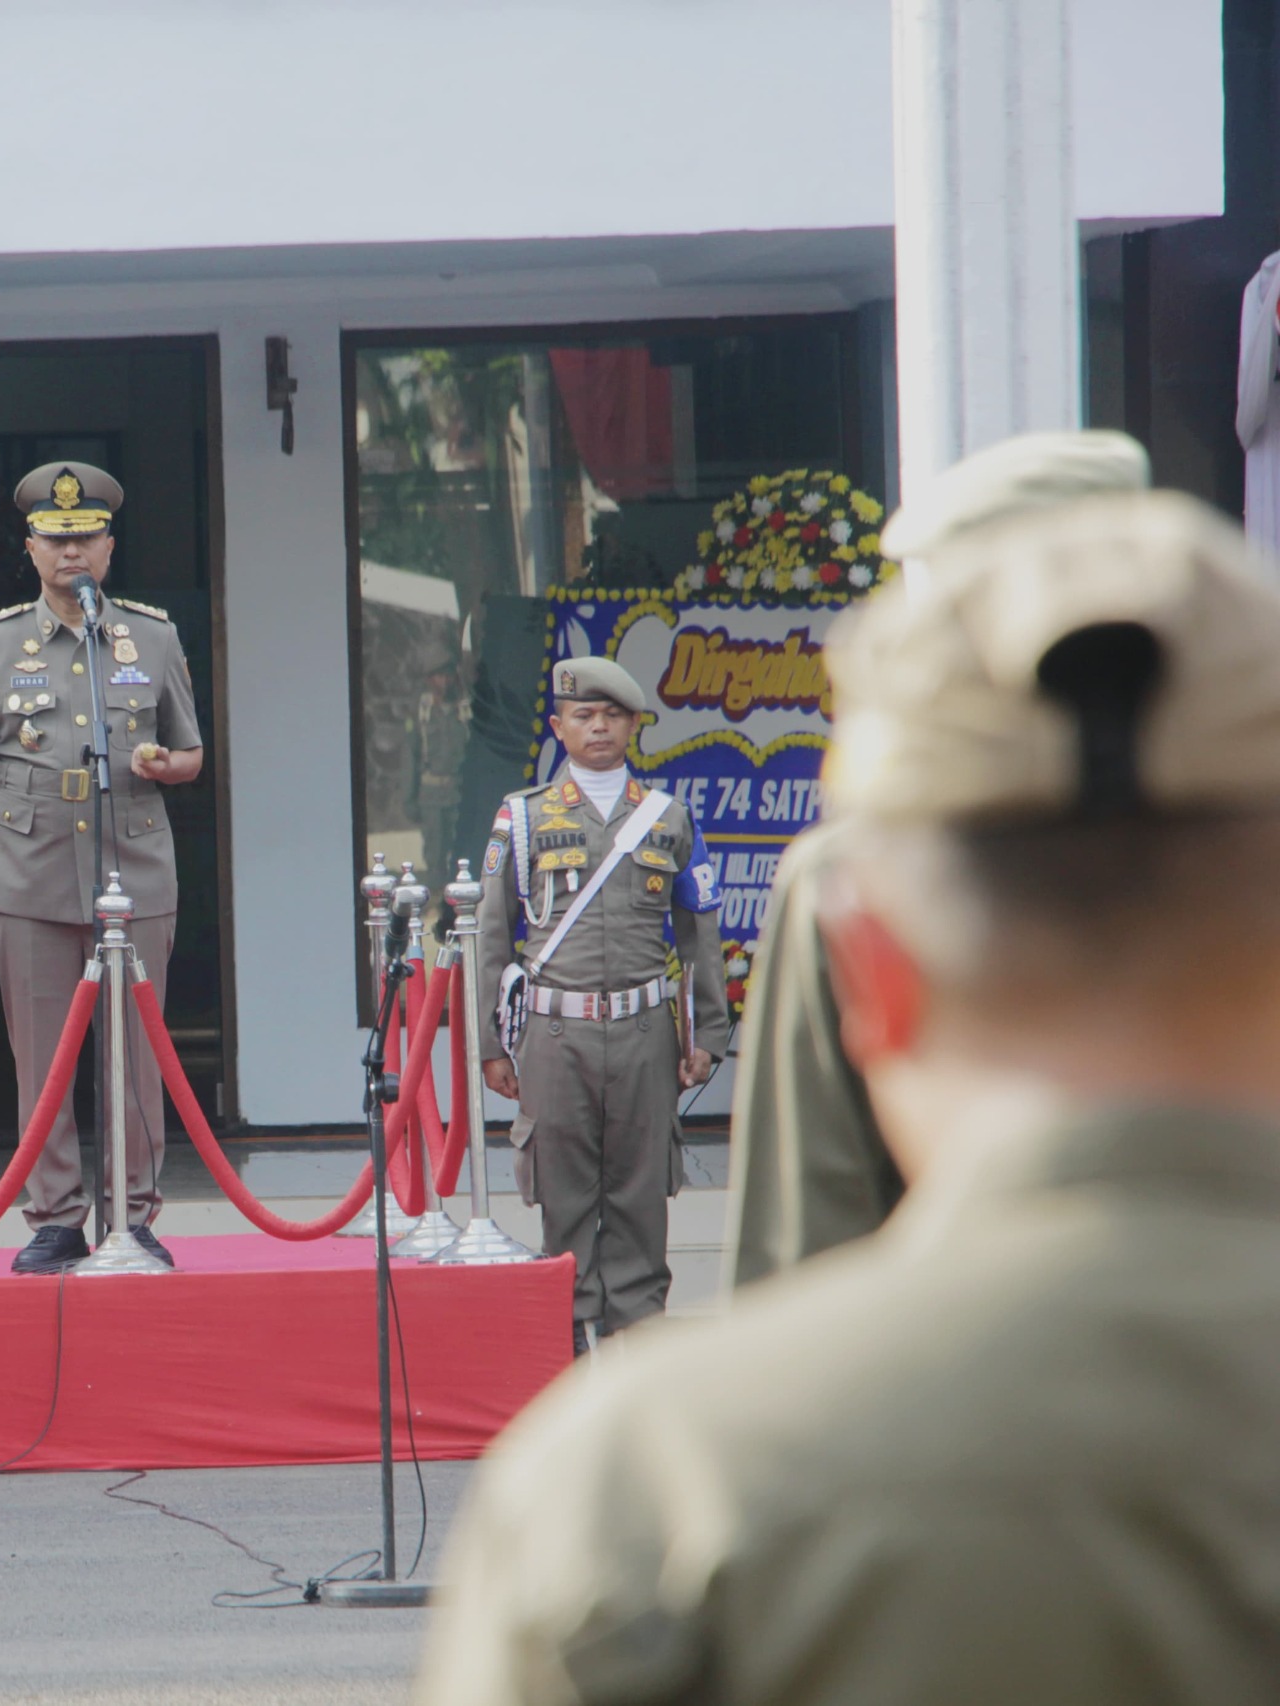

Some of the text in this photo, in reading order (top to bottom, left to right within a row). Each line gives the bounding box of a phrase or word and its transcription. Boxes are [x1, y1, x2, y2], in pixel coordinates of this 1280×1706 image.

[674, 777, 709, 820] KE
[712, 777, 752, 821] 74
[691, 863, 715, 903] P
